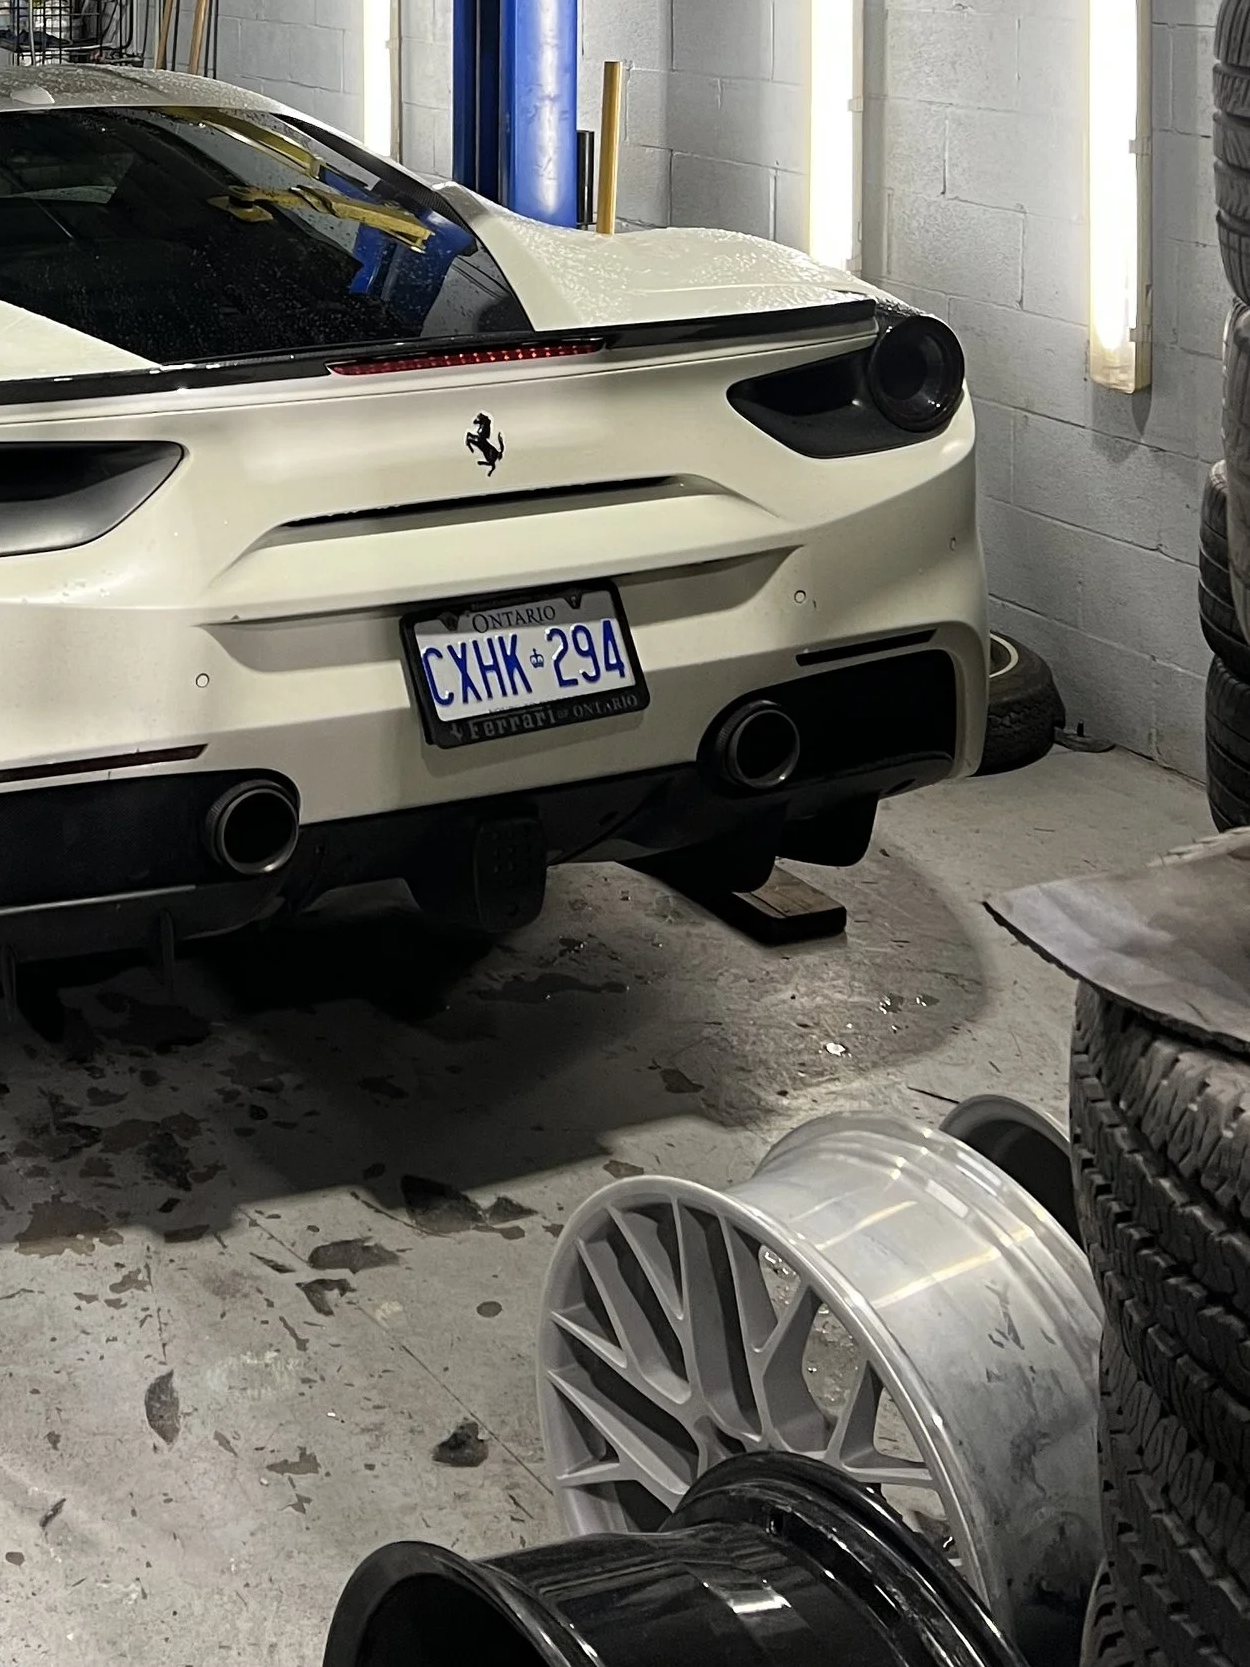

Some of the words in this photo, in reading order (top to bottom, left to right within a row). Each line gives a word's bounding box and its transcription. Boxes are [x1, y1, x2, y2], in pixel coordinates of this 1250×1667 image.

[472, 604, 557, 634] ONTARIO
[422, 633, 533, 708] CXHK
[545, 619, 626, 688] 294
[469, 704, 556, 741] Ferrari
[573, 693, 639, 719] ONTARIO
